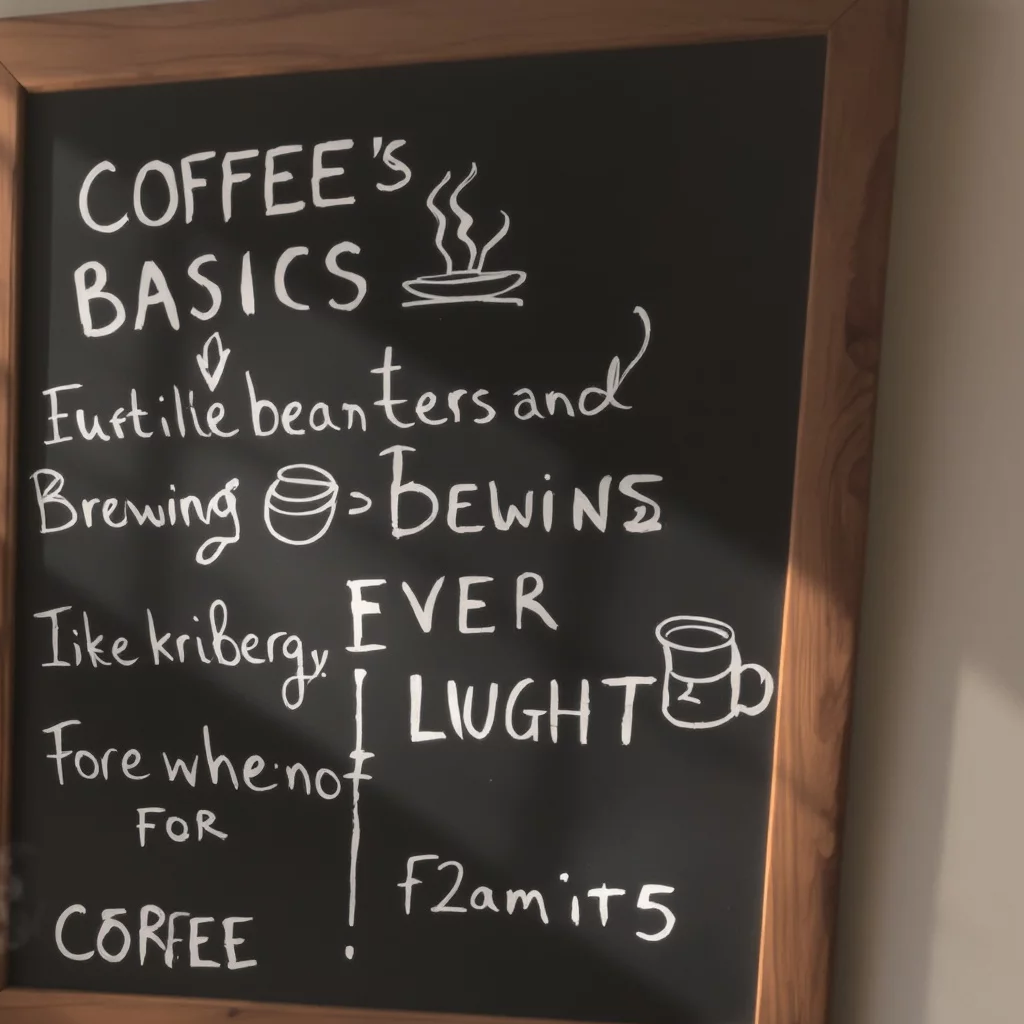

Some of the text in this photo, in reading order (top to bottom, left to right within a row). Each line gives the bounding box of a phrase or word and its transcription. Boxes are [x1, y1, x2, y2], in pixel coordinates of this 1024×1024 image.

[79, 137, 412, 233] COFFEE's
[74, 241, 368, 338] BASICS
[30, 468, 241, 566] Brewing
[345, 572, 559, 652] EVER
[136, 807, 229, 847] FOR
